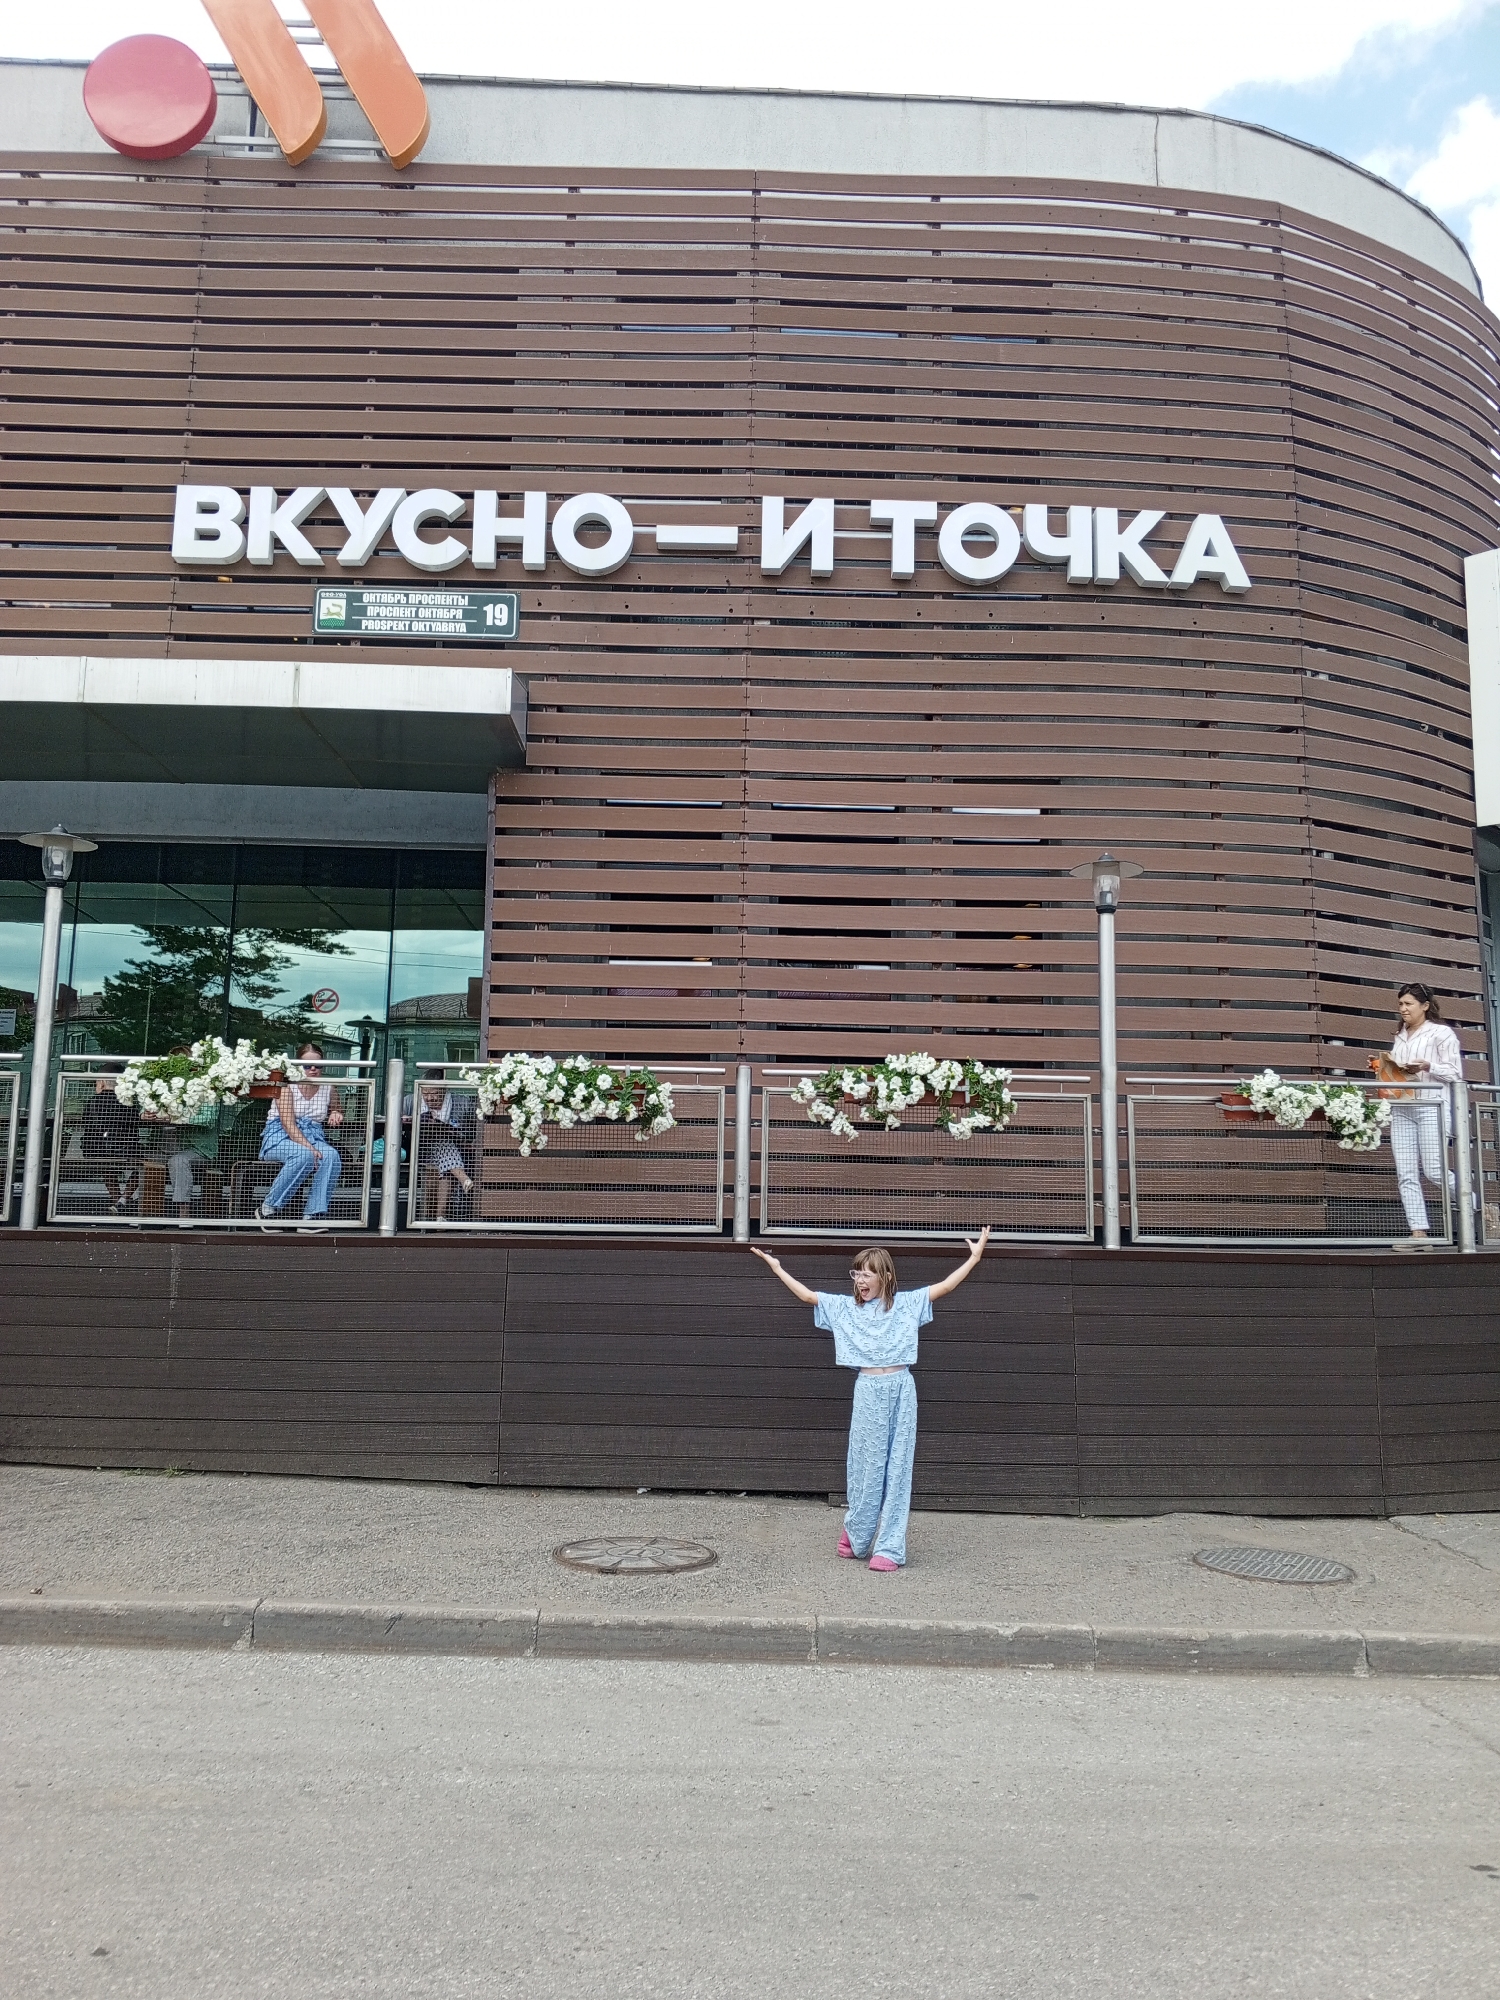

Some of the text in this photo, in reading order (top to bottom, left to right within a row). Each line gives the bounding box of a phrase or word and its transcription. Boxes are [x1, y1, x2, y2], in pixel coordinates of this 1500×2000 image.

[171, 484, 635, 576] ВКУСНО
[760, 496, 835, 578] И
[869, 500, 1253, 594] ТОЧКА
[366, 605, 463, 620] ПРОСПЕКТ ОКТЯБРЯ
[482, 603, 509, 627] 19
[361, 619, 467, 633] PROSPEKT OKTYABRYA
